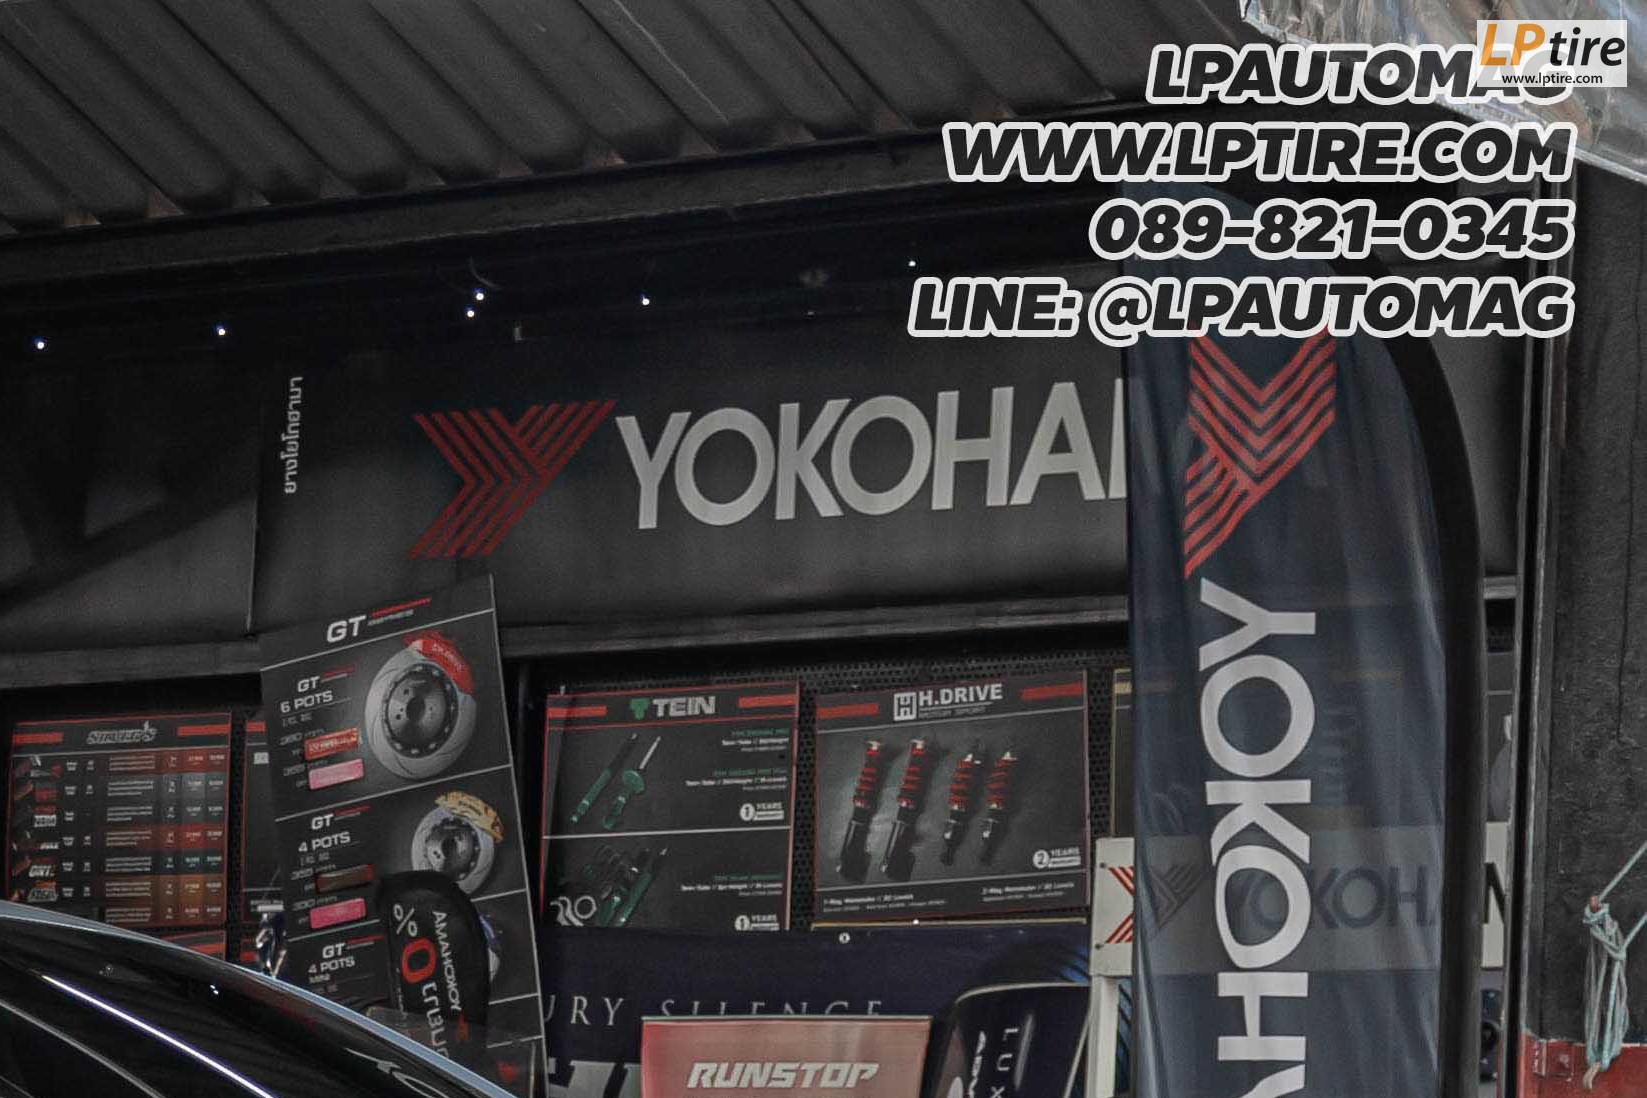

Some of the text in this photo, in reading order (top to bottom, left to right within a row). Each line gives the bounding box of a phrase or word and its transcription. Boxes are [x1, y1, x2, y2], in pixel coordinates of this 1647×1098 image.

[616, 379, 1126, 530] YOKOHA
[327, 614, 367, 643] GT
[297, 676, 321, 693] GT
[919, 683, 1003, 707] H.DRIVE
[280, 690, 333, 713] 6 POTS
[653, 696, 716, 717] TEIN
[311, 813, 334, 830] GT
[298, 831, 351, 852] 4 POTS
[322, 942, 346, 959] GT
[320, 955, 355, 972] POTS
[686, 1062, 880, 1088] RUNSTOP
